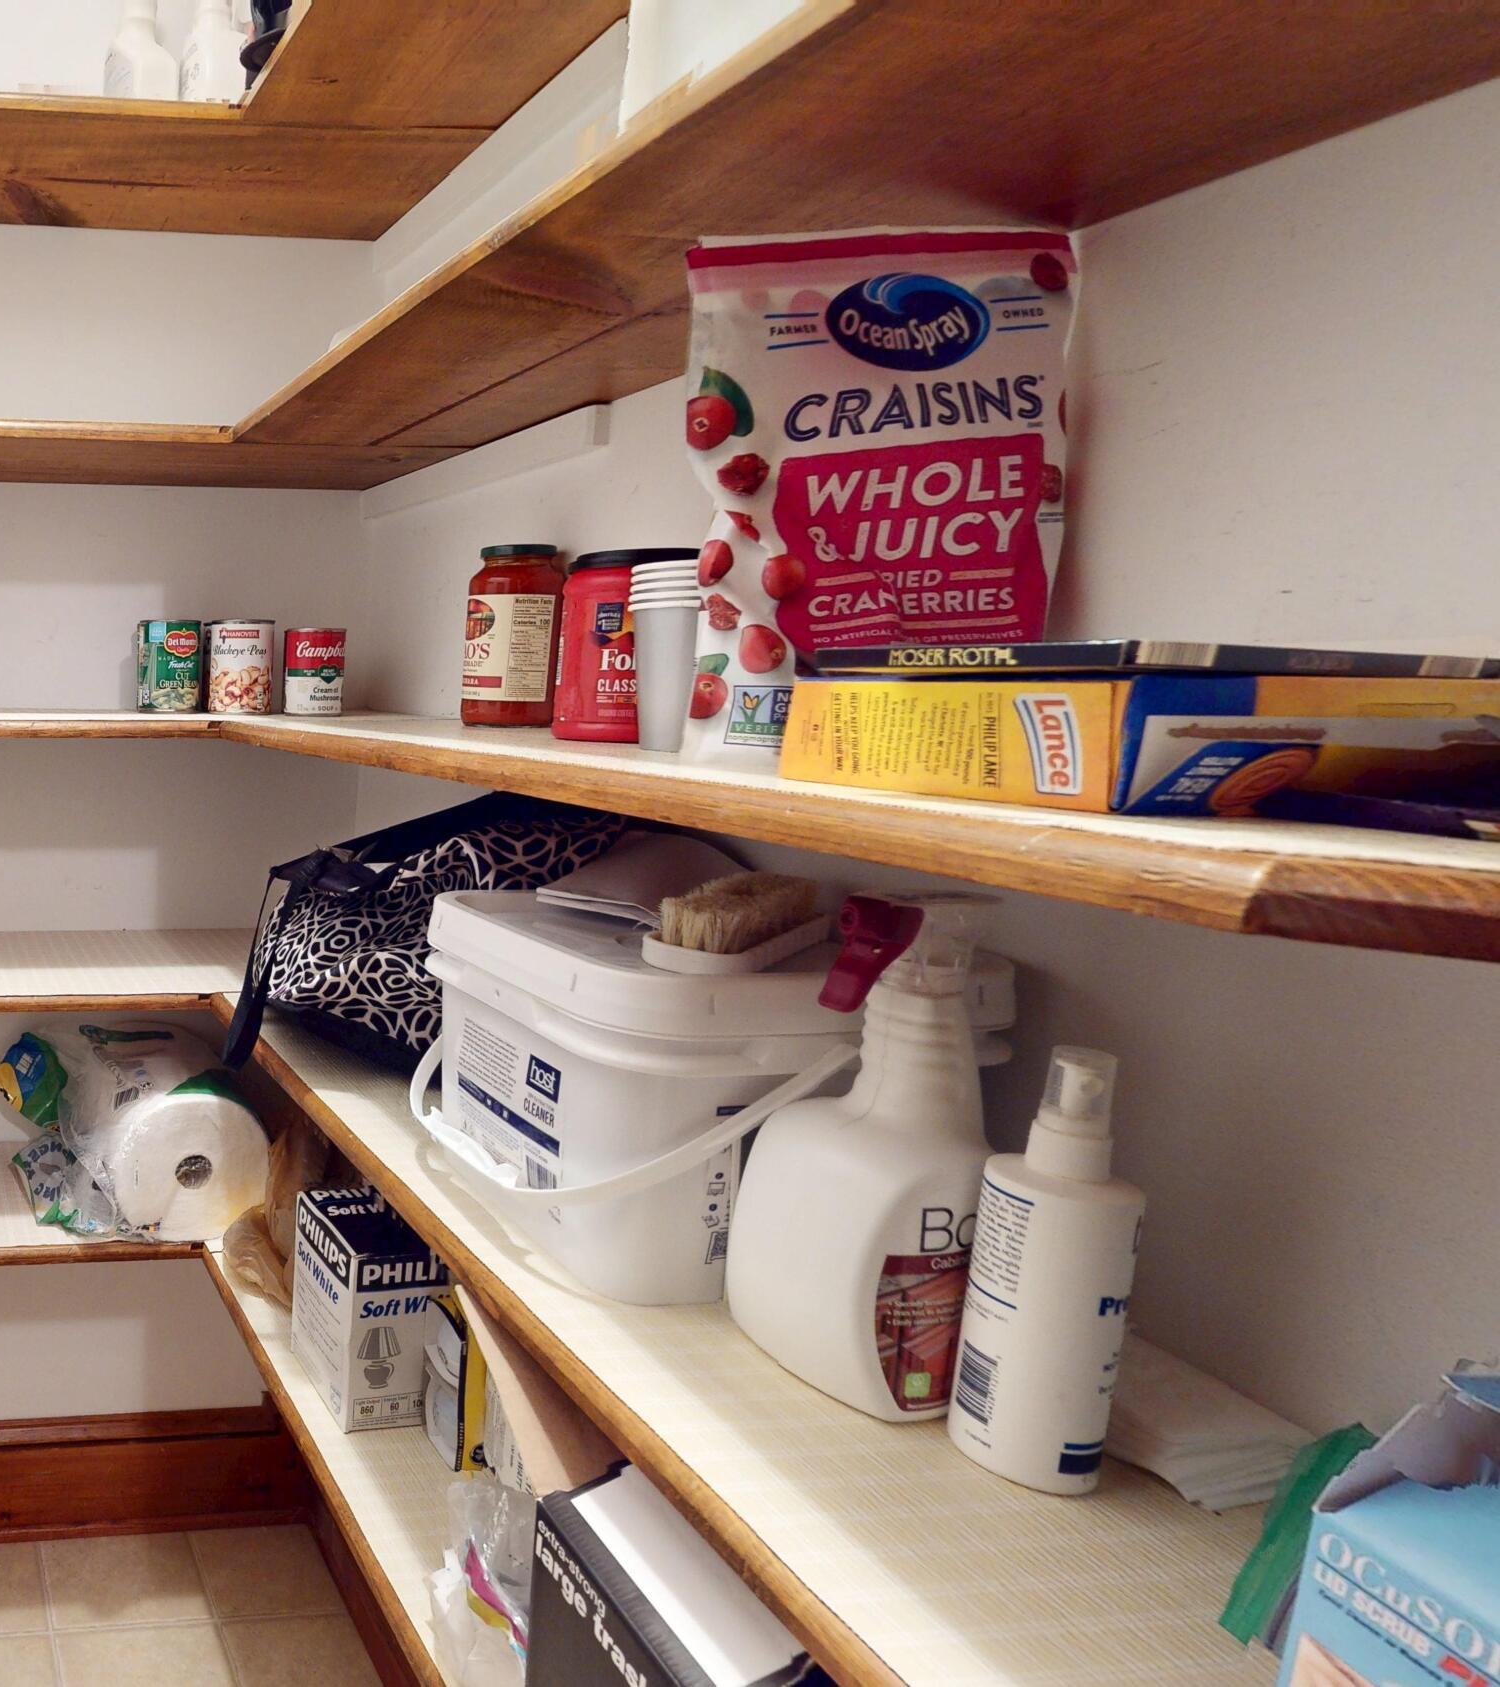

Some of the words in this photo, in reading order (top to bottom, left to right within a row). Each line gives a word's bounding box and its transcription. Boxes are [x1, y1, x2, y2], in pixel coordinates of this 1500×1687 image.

[1003, 307, 1044, 319] OWNED
[769, 324, 818, 337] FARMER
[838, 308, 910, 350] Ocean
[910, 304, 973, 356] Spray
[784, 374, 1044, 442] CRAISINS
[806, 454, 1025, 517] WHOLE
[807, 526, 845, 562] &
[849, 508, 1024, 562] JUICY
[880, 568, 944, 589] RIED
[807, 587, 1015, 617] CRANERRIES
[813, 636, 831, 645] NO
[834, 629, 893, 642] ARTIFICIAL
[941, 629, 1024, 643] PRESERVATIVES
[213, 644, 245, 658] Blackeye
[247, 644, 267, 658] Peas
[464, 642, 490, 660] O'S
[888, 648, 945, 666] MOSER
[160, 679, 183, 689] GREEN
[313, 686, 332, 694] Cream
[834, 693, 842, 723] GETTING
[851, 692, 859, 714] HELPS
[836, 725, 842, 733] IN
[851, 717, 859, 734] KEEP
[983, 717, 997, 752] PHILIP
[852, 737, 860, 750] YOU
[1033, 697, 1072, 787] Lance
[983, 754, 997, 786] LANCE
[531, 1060, 556, 1091] host
[524, 1098, 555, 1128] CLEANER
[327, 1204, 367, 1216] Soft
[299, 1206, 347, 1277] PHILIPS
[297, 1241, 313, 1271] Soft
[312, 1263, 340, 1304] White
[360, 1296, 400, 1318] Soft
[360, 1405, 375, 1415] 860
[389, 1402, 400, 1411] 60
[535, 1532, 588, 1618] large
[537, 1520, 606, 1618] extra-strong
[1352, 1590, 1431, 1657] SCRUB
